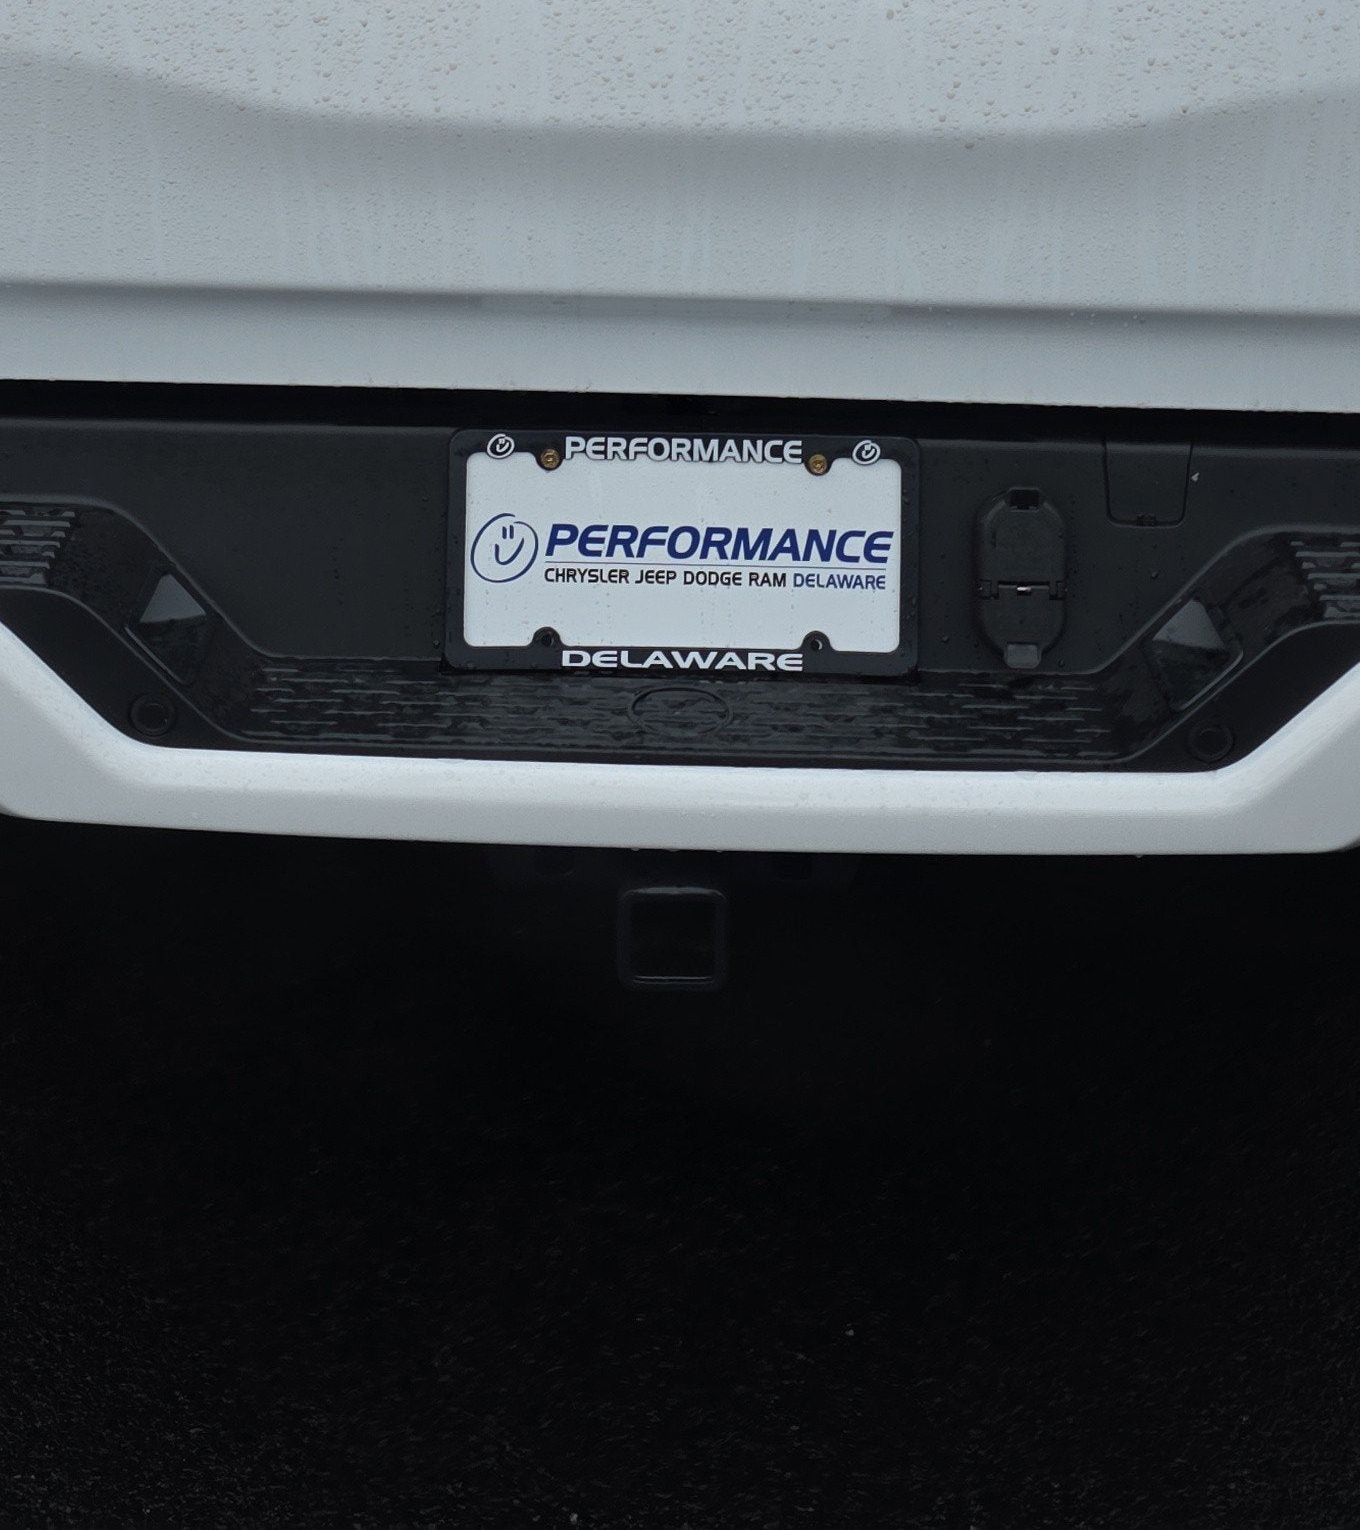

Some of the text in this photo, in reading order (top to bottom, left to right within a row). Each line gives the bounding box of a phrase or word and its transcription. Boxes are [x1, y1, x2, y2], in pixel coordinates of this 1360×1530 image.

[565, 436, 803, 465] PERFORMANCE
[545, 523, 894, 564] PERFORMANCE
[544, 568, 887, 590] CHRYSLER JEEP DODGE RAM DELAWARE
[562, 650, 803, 671] DELAWARE
